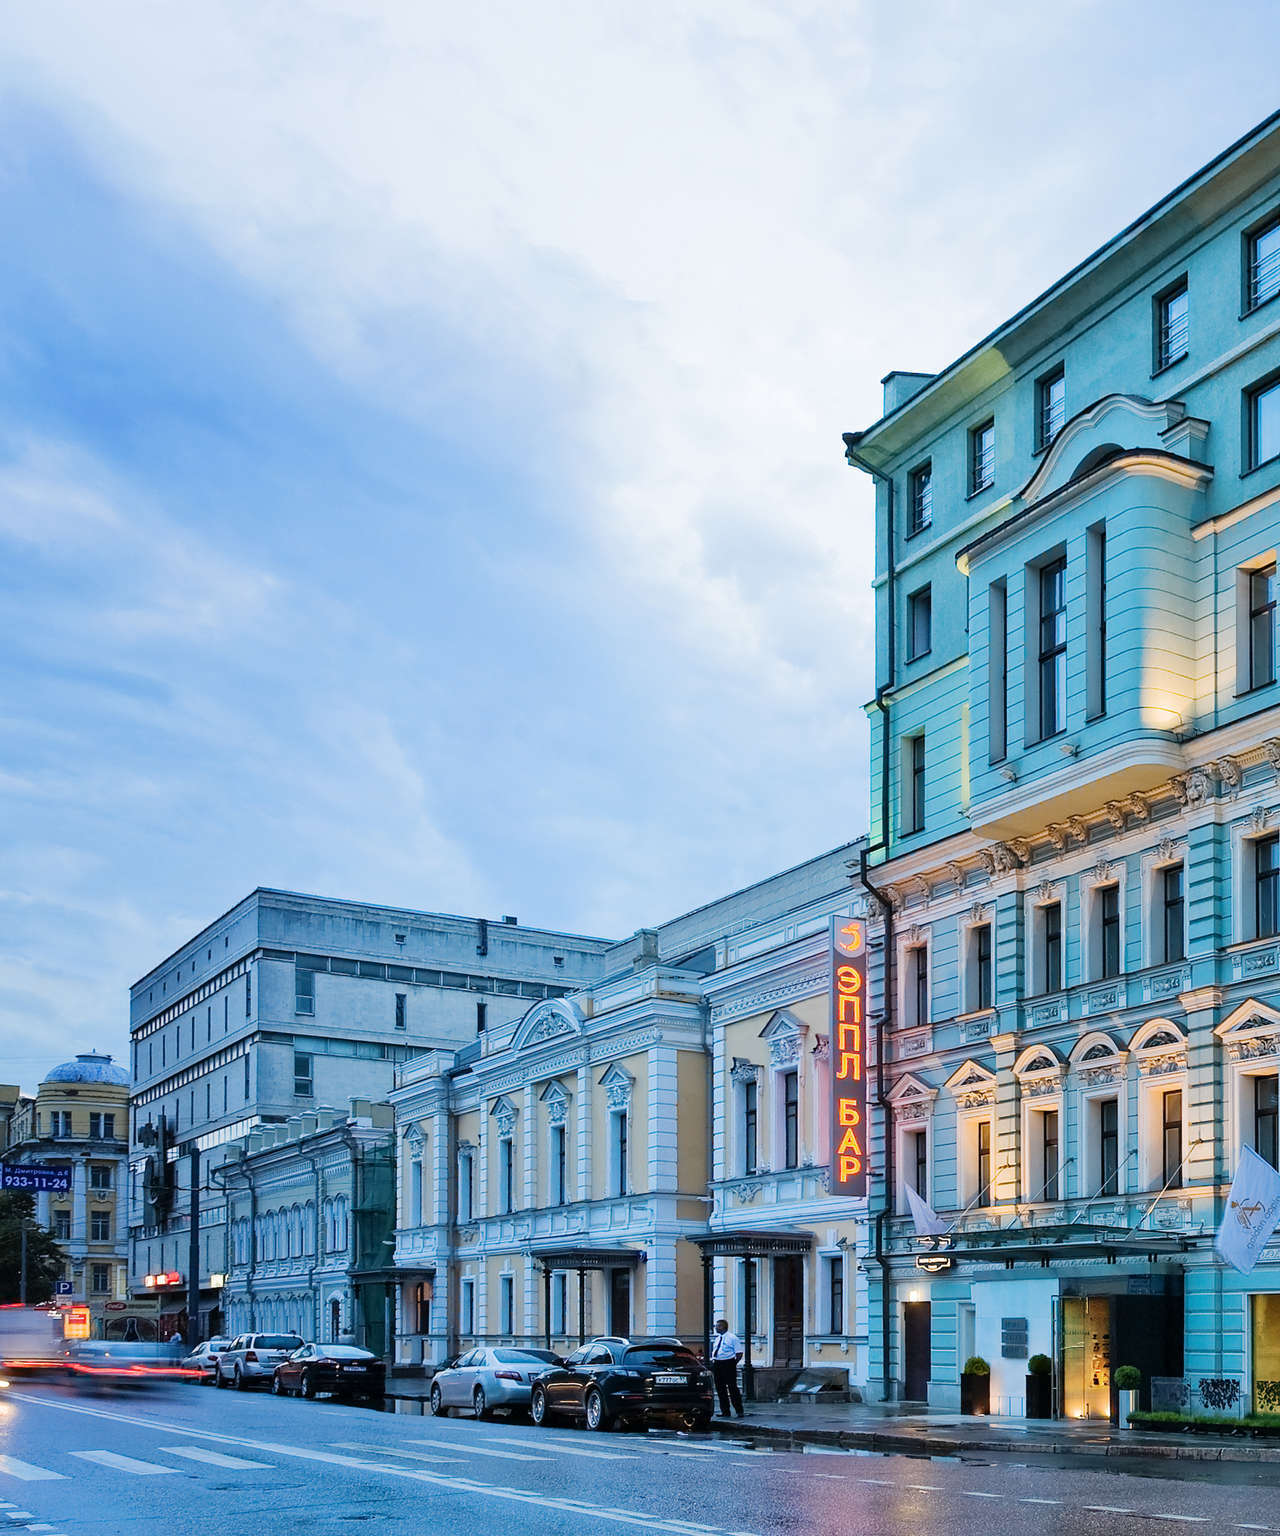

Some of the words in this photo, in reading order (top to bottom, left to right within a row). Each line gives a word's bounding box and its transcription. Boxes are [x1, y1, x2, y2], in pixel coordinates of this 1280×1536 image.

[836, 965, 862, 1081] ЭППЛ
[837, 1098, 862, 1182] БАР
[5, 1176, 68, 1189] 933-11-24
[60, 1282, 70, 1293] P
